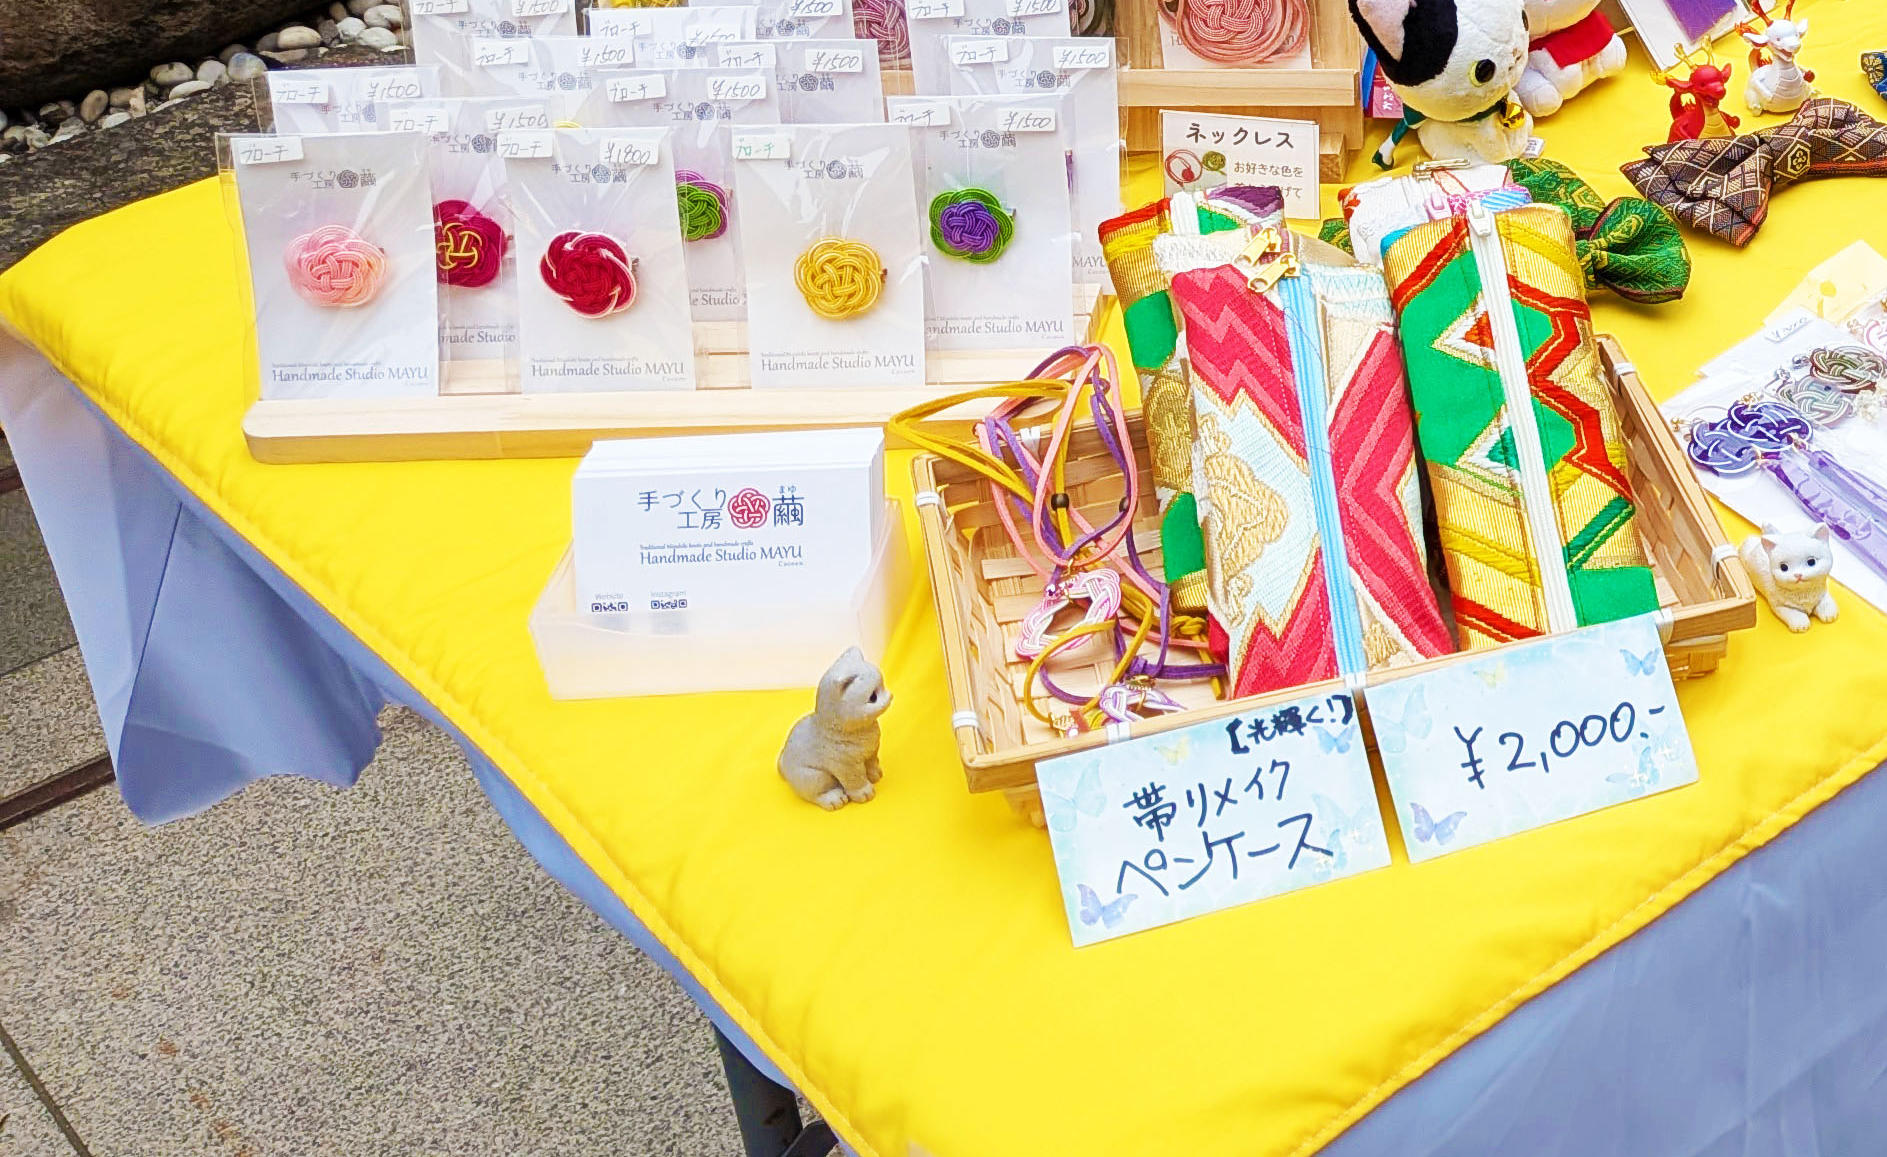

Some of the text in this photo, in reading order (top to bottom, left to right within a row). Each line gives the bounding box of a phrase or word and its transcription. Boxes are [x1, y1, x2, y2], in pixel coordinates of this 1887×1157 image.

[582, 49, 626, 65] ¥1500
[811, 51, 860, 70] ¥1500
[1059, 48, 1106, 65] ¥1500
[368, 79, 418, 100] ¥1500
[710, 80, 760, 99] ¥1500
[1003, 114, 1051, 130] ¥1500
[1186, 123, 1294, 149] ネックレス
[604, 141, 650, 163] ¥1800
[1234, 161, 1303, 178] お好きな色を
[926, 319, 1064, 334] andmade Studio MAYU
[442, 330, 474, 344] made
[532, 362, 685, 377] Handmade Studio MAYU
[761, 357, 829, 372] Handmade
[832, 356, 871, 369] Studio
[874, 354, 915, 368] MAYU
[272, 367, 428, 382] Handmade Studio MAYU
[638, 489, 728, 512] 手づくり
[677, 510, 723, 530] 工房
[772, 494, 804, 527] 繭
[640, 544, 802, 565] Handmade Studio MAYU
[1123, 759, 1292, 842] 帯リメイク
[1116, 812, 1334, 897] ペンケース
